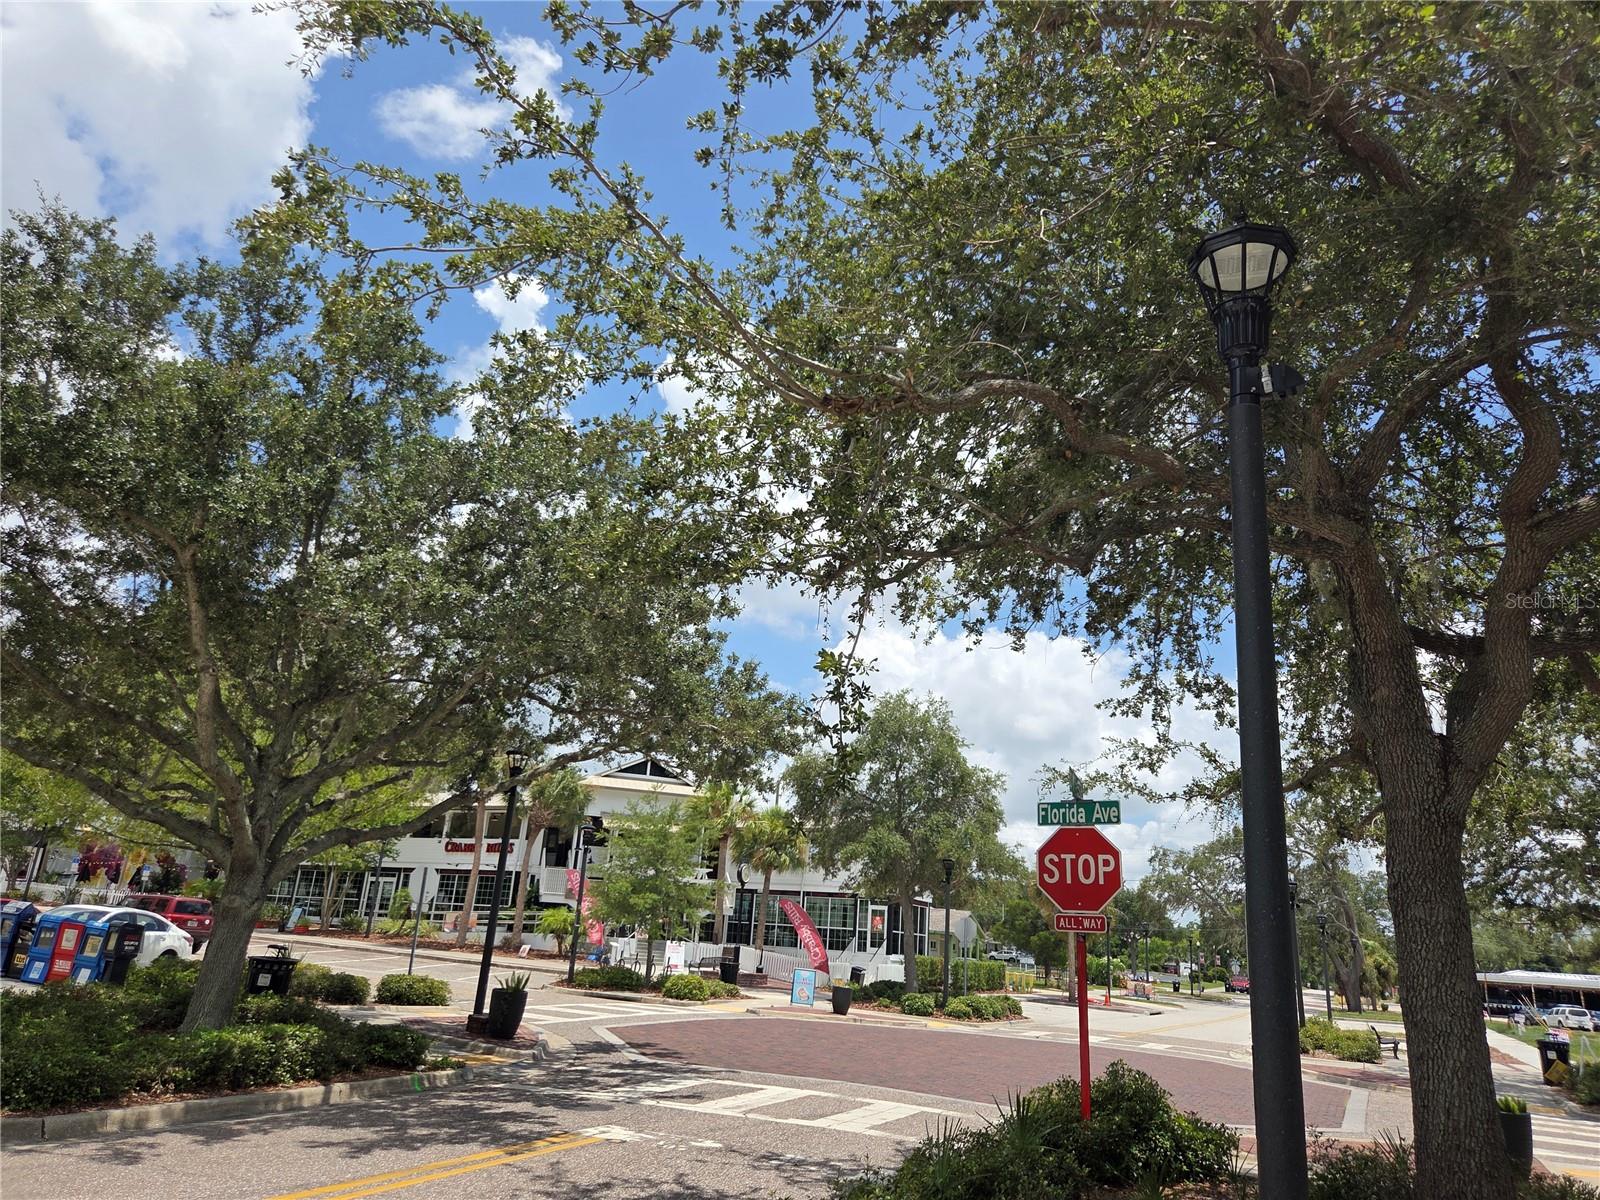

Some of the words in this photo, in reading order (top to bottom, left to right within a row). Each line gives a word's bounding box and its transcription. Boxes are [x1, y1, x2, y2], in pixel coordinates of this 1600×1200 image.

[1039, 803, 1086, 824] Florida
[1092, 802, 1119, 823] Ave
[1043, 853, 1116, 885] STOP
[1059, 917, 1077, 928] ALL
[1082, 918, 1102, 929] WAY
[800, 924, 821, 960] Crabby
